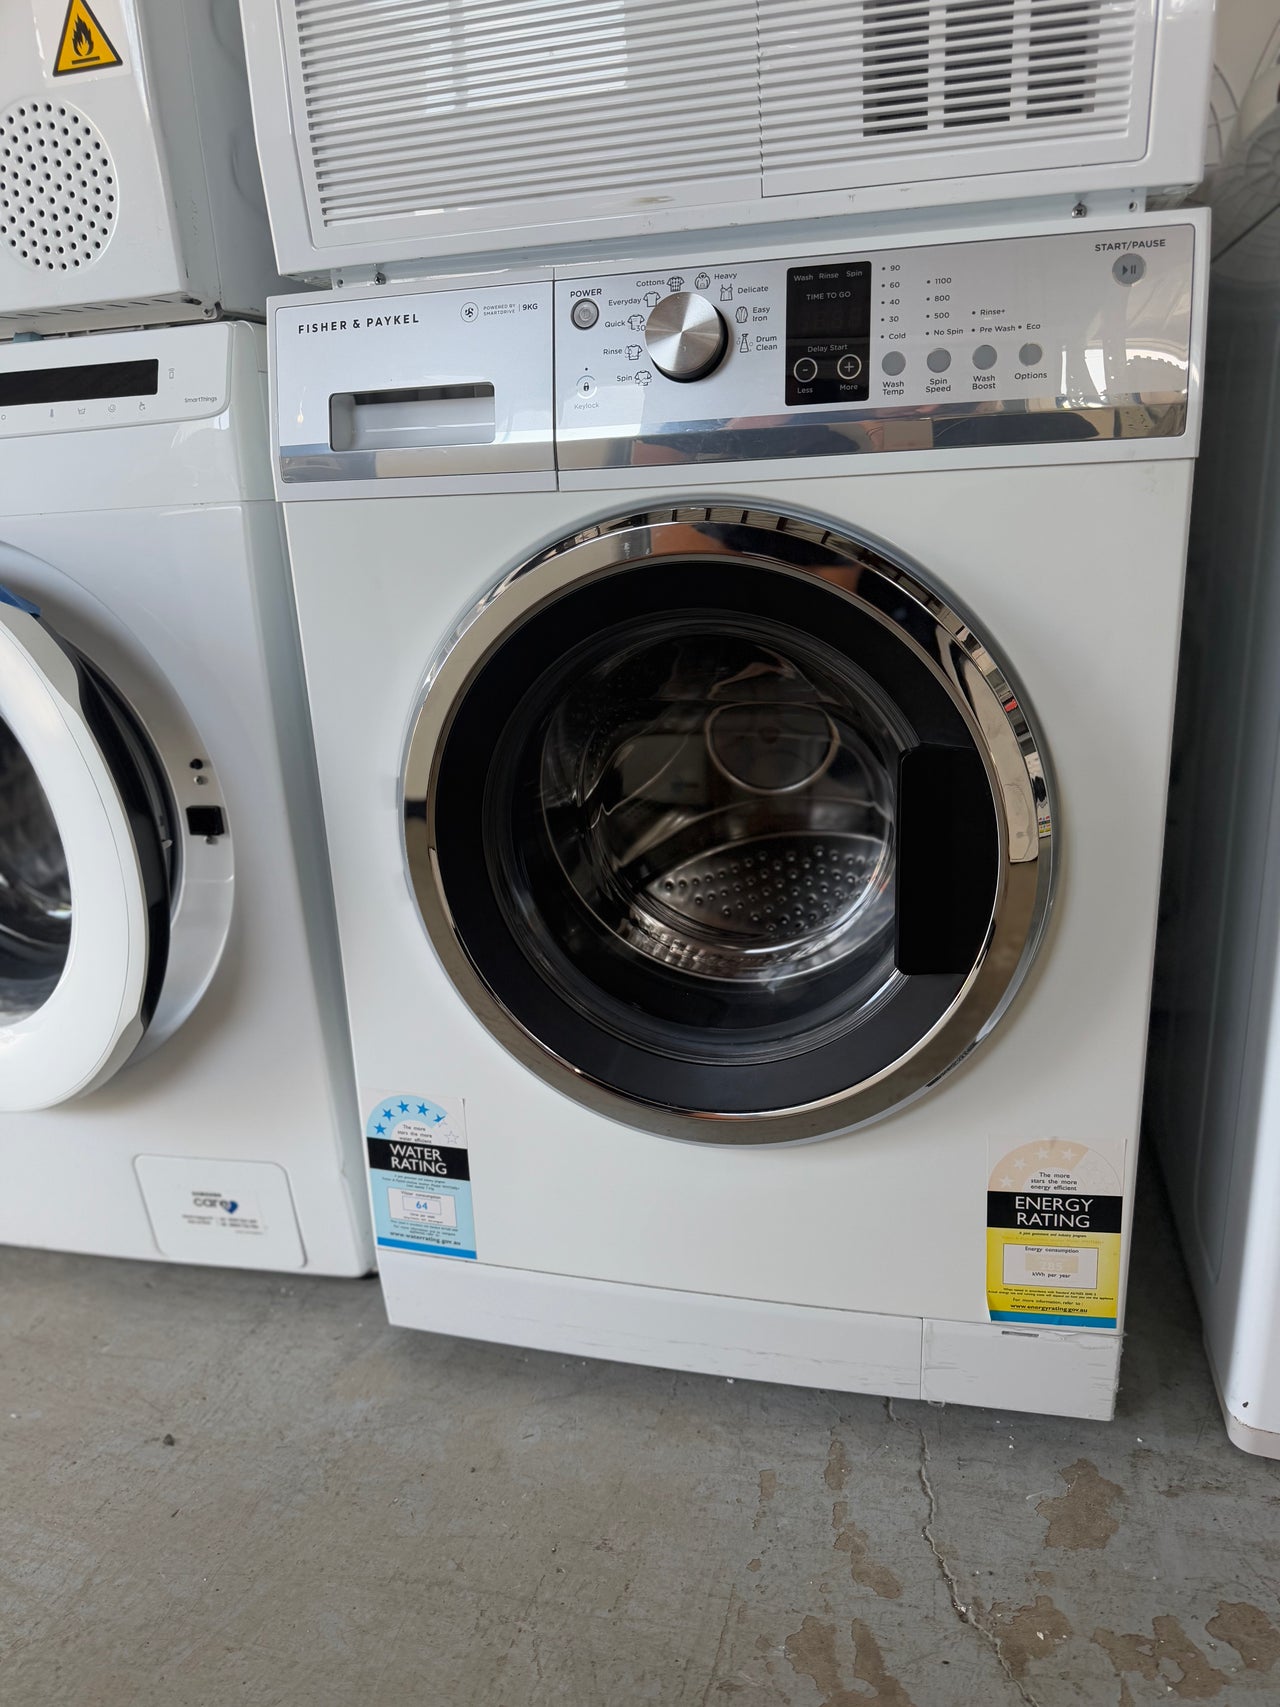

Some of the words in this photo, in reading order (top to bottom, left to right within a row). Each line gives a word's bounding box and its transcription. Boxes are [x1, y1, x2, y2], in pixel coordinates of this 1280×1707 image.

[1095, 239, 1166, 251] START/PAUSE
[714, 272, 738, 280] Heavy
[794, 274, 814, 282] Wash
[819, 272, 839, 280] Rinse
[846, 270, 862, 278] Spin
[636, 279, 665, 288] Cottons
[570, 289, 602, 298] POWER
[738, 285, 769, 294] Delicate
[806, 293, 824, 301] TIME
[608, 297, 642, 307] Everyday
[753, 306, 770, 314] Easy
[980, 308, 1005, 316] Rinse+
[298, 321, 347, 334] FISHER
[352, 320, 360, 329] &
[367, 314, 419, 327] PAYKEL
[605, 320, 626, 328] Quick
[1026, 322, 1041, 330] Eco
[947, 328, 964, 336] Spin
[980, 326, 993, 334] Pre
[995, 324, 1016, 333] Wash
[756, 335, 777, 343] Drum
[604, 347, 623, 355] Rinse
[756, 343, 778, 351] Clean
[808, 345, 828, 353] Delay
[830, 344, 848, 352] Start
[617, 374, 632, 382] Spin
[973, 374, 996, 382] Wash
[1014, 371, 1048, 381] Options
[930, 378, 948, 386] Spin
[972, 382, 996, 391] Boost
[797, 386, 813, 394] Less
[883, 388, 904, 396] Temp
[926, 385, 951, 394] Speed
[185, 396, 217, 404] SmartThings
[574, 402, 600, 410] Keylock
[390, 1143, 442, 1161] WATER
[391, 1157, 447, 1175] RATING
[416, 1201, 428, 1210] 64
[1016, 1196, 1094, 1212] ENERGY
[1017, 1212, 1090, 1228] RATING
[1011, 1304, 1088, 1313] www.energyrating.gov.au
